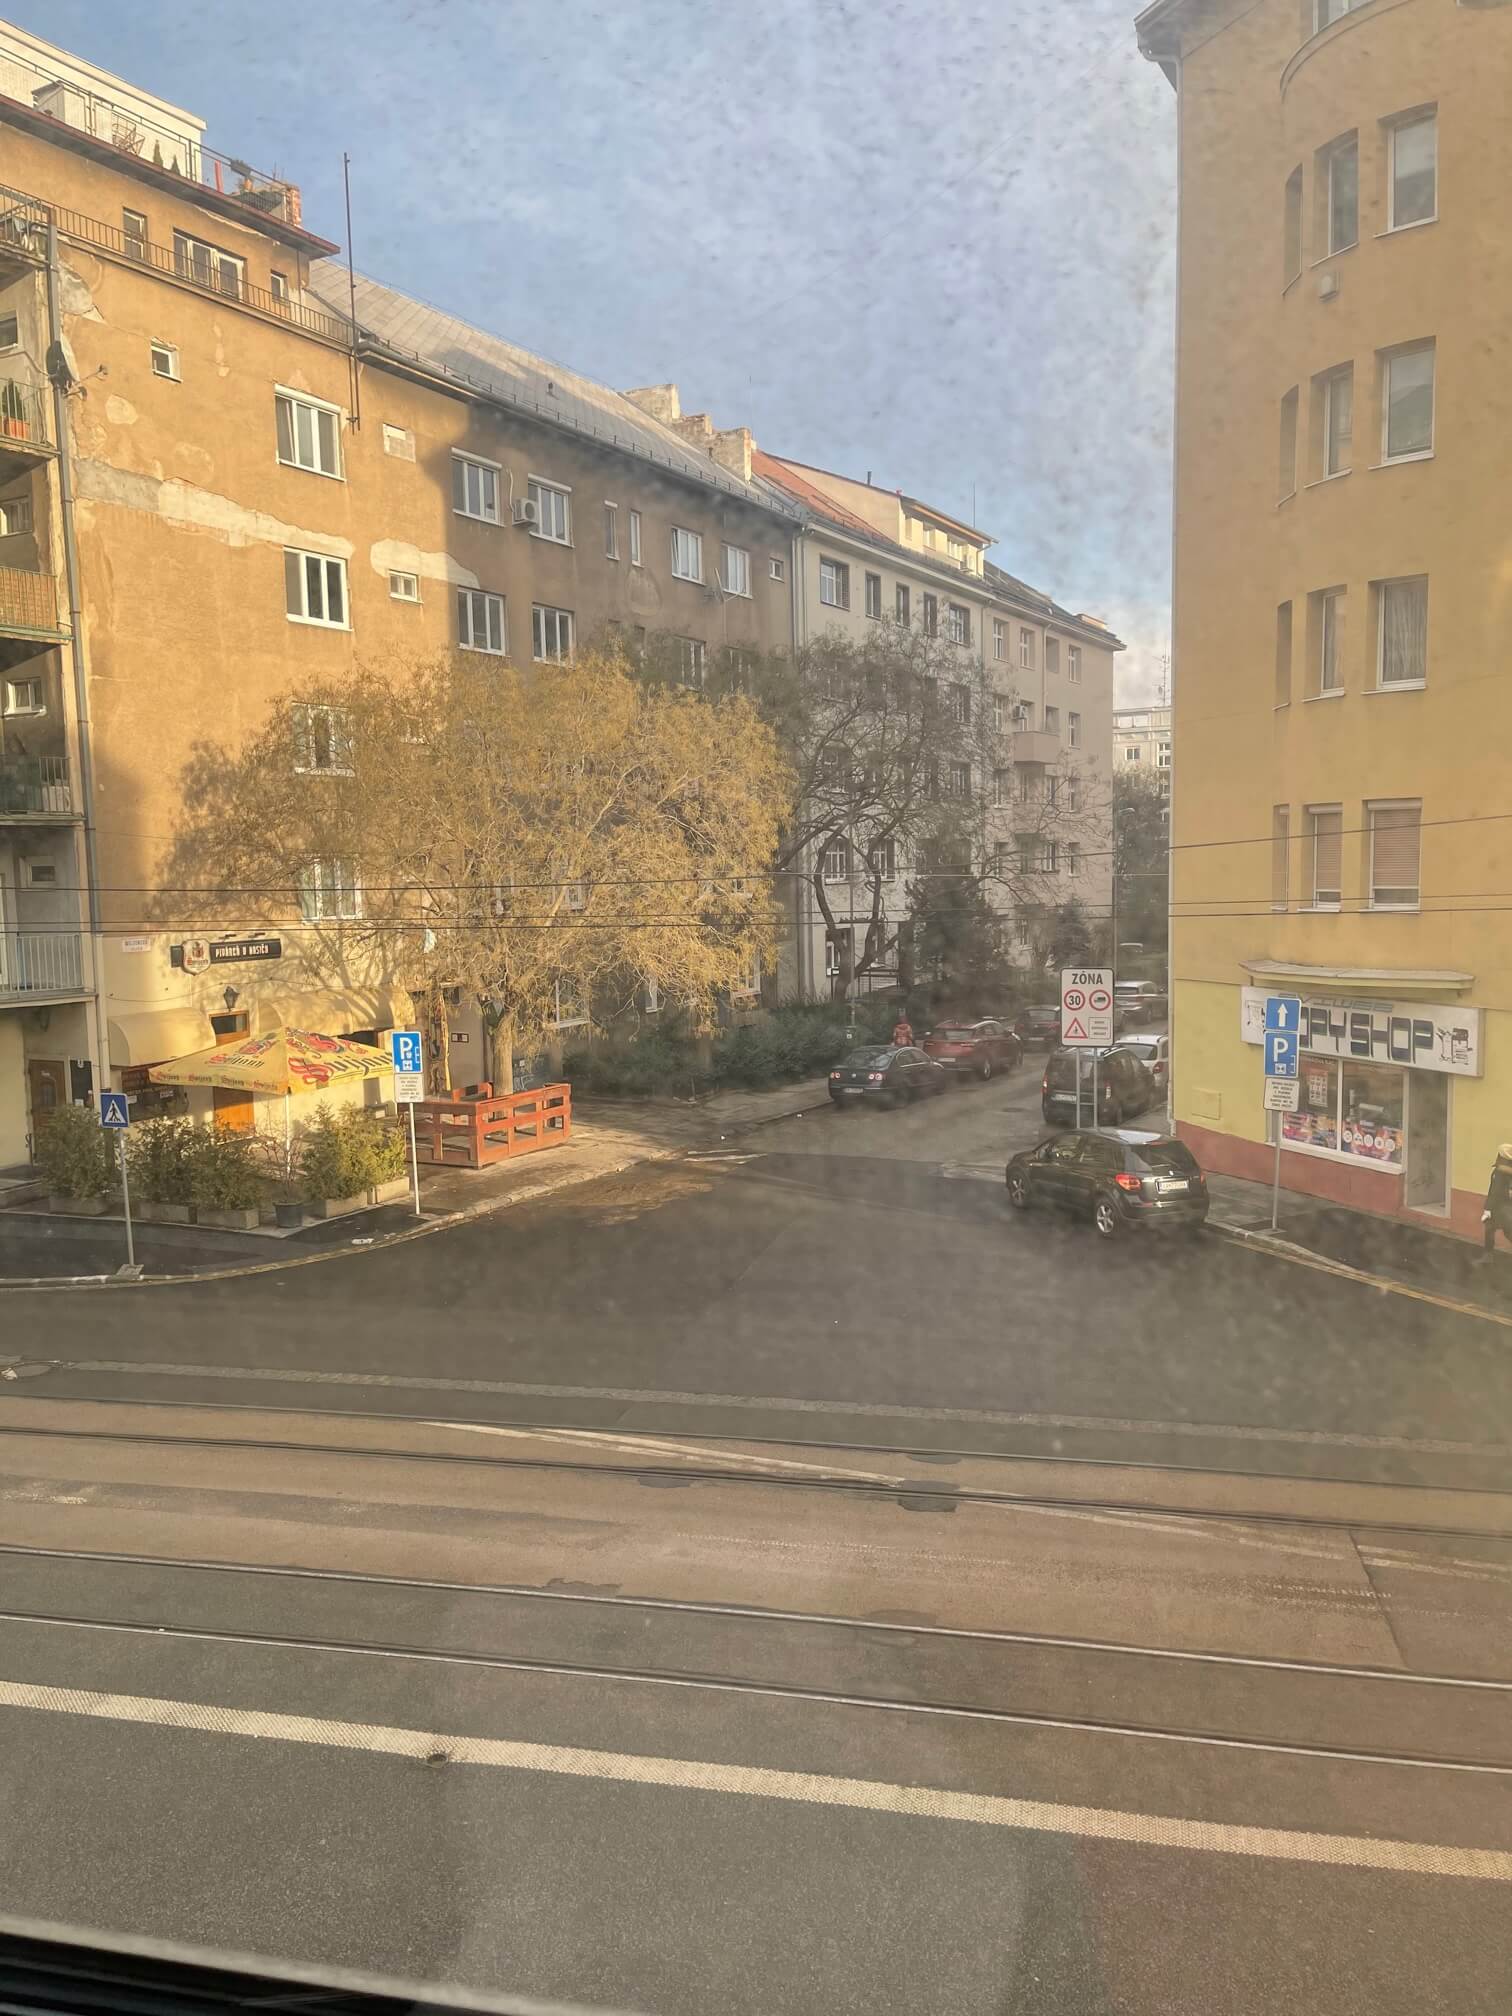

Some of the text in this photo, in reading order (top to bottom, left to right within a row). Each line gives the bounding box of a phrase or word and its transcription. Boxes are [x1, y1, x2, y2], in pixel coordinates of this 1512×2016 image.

[1068, 995, 1081, 1006] 30
[399, 1037, 413, 1060] P
[1273, 1037, 1289, 1062] P
[288, 1052, 393, 1084] Svijan
